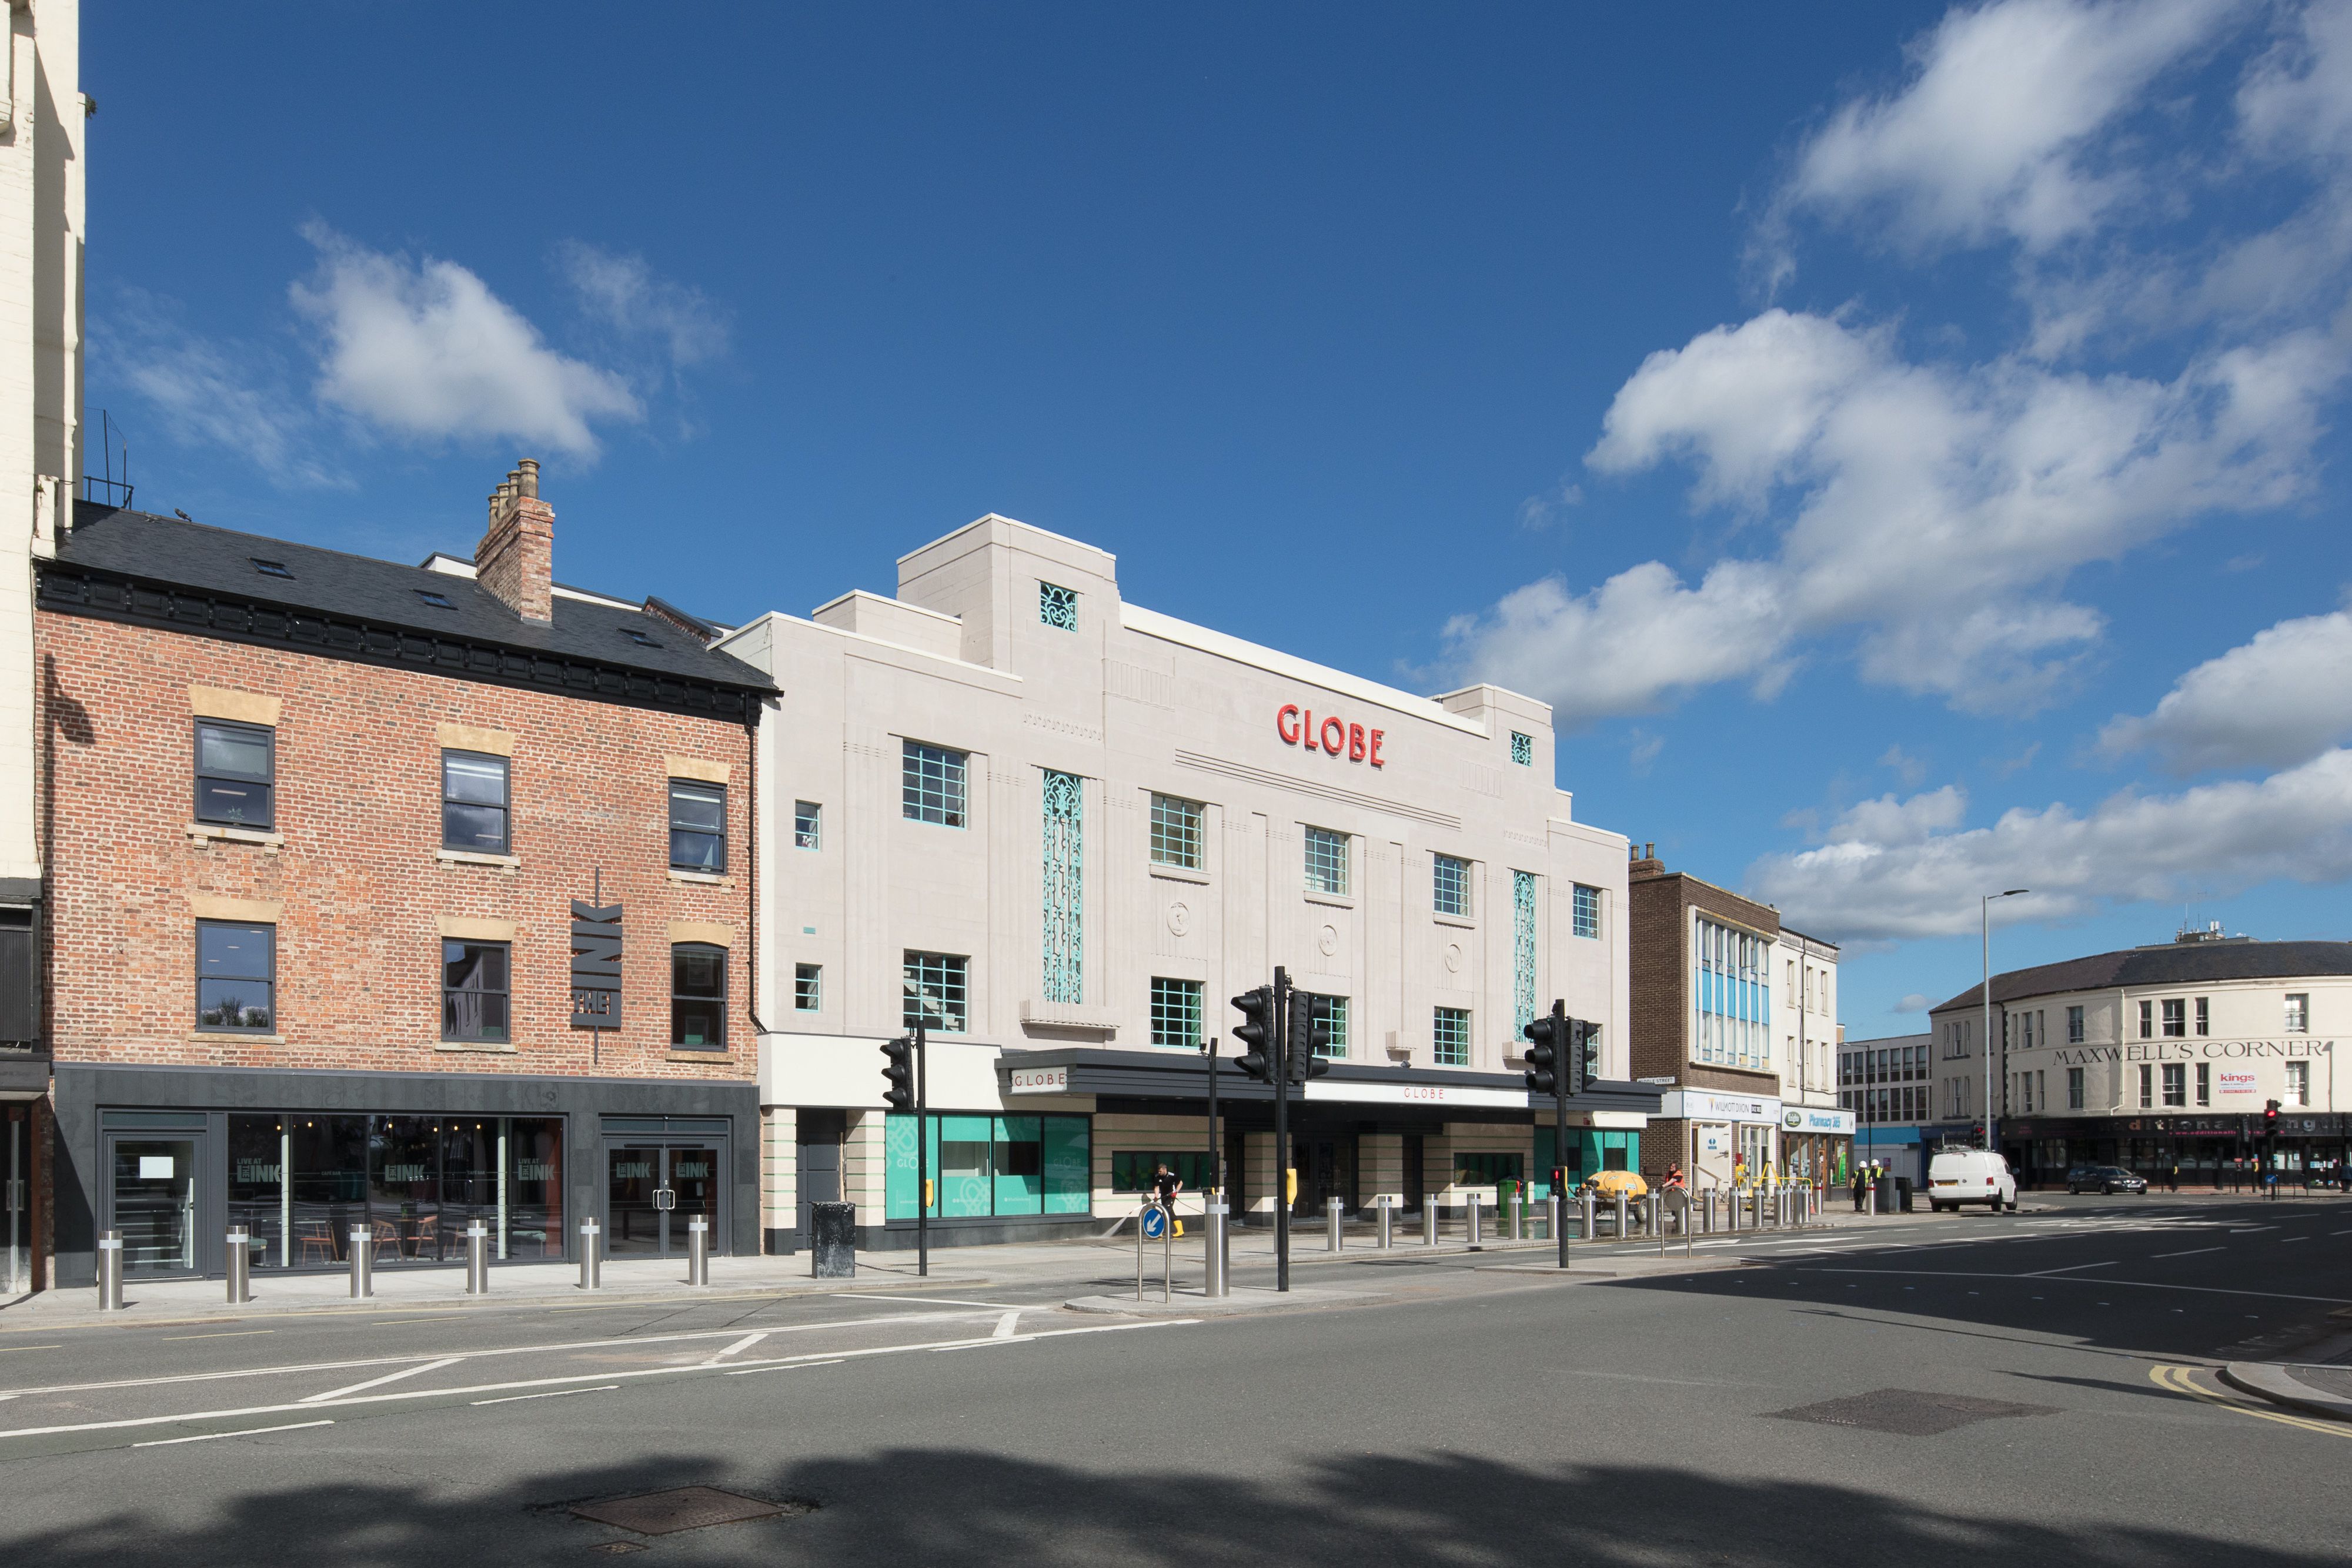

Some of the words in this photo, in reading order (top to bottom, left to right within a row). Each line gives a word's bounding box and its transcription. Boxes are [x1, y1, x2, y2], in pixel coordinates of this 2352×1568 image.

[1277, 703, 1386, 766] GLOBE
[2052, 1044, 2194, 1066] MAXWELL'S
[2203, 1040, 2323, 1058] CORNER
[1014, 1073, 1065, 1086] GLOBE
[2220, 1073, 2255, 1083] kings
[1404, 1088, 1444, 1099] GLOBE
[1715, 1101, 1735, 1112] WILLMOTT
[1736, 1103, 1749, 1113] DIXON
[1809, 1113, 1832, 1131] Pharmacy
[616, 1162, 651, 1178] LINK
[676, 1162, 709, 1178] LINK
[897, 1156, 929, 1169] GLOE
[237, 1165, 281, 1183] LINK
[385, 1165, 425, 1182] LINK
[518, 1164, 555, 1181] LINK
